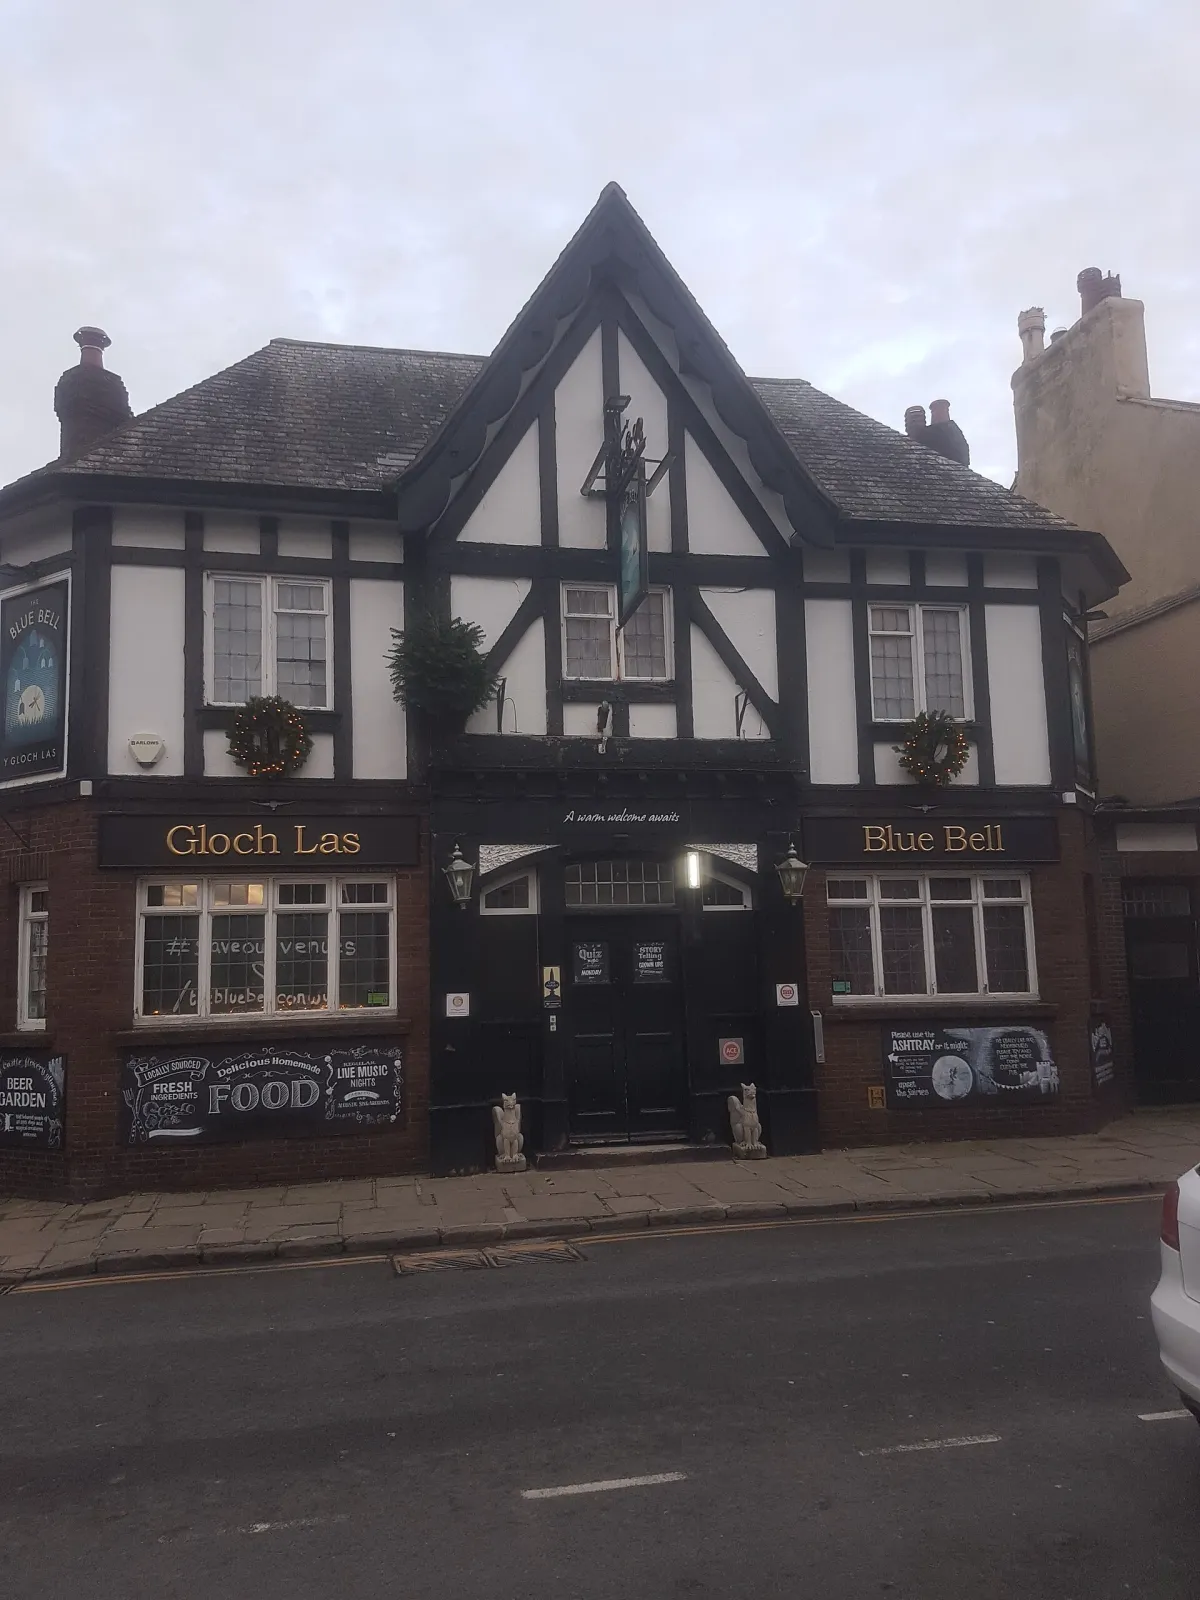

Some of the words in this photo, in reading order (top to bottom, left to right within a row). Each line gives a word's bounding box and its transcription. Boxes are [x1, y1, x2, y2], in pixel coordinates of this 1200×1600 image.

[9, 610, 35, 641] BLUE
[38, 609, 60, 630] BELL
[3, 758, 8, 767] Y
[10, 749, 38, 766] GLOCH
[41, 748, 56, 760] LAS
[563, 810, 575, 823] A
[577, 813, 605, 822] warm
[607, 807, 646, 822] welcome
[648, 811, 680, 822] awaits
[166, 824, 280, 855] Gloch
[294, 825, 361, 854] Las
[862, 824, 934, 852] Blue
[943, 824, 1005, 852] Bell
[578, 948, 603, 960] Quiz
[638, 953, 662, 961] Telling
[892, 1039, 935, 1051] ASHTRAY
[143, 1063, 170, 1081] LOCALLY
[171, 1060, 201, 1071] SOURCED
[216, 1057, 270, 1078] Delicious
[272, 1057, 321, 1075] Homemade
[337, 1066, 355, 1079] LIVE
[357, 1064, 388, 1078] MUSIC
[7, 1077, 33, 1091] BEER
[153, 1081, 192, 1094] FRESH
[350, 1078, 376, 1087] NIGHTS
[0, 1091, 46, 1108] GARDEN
[151, 1092, 198, 1101] INGREDIENTS
[208, 1079, 320, 1114] FOOD
